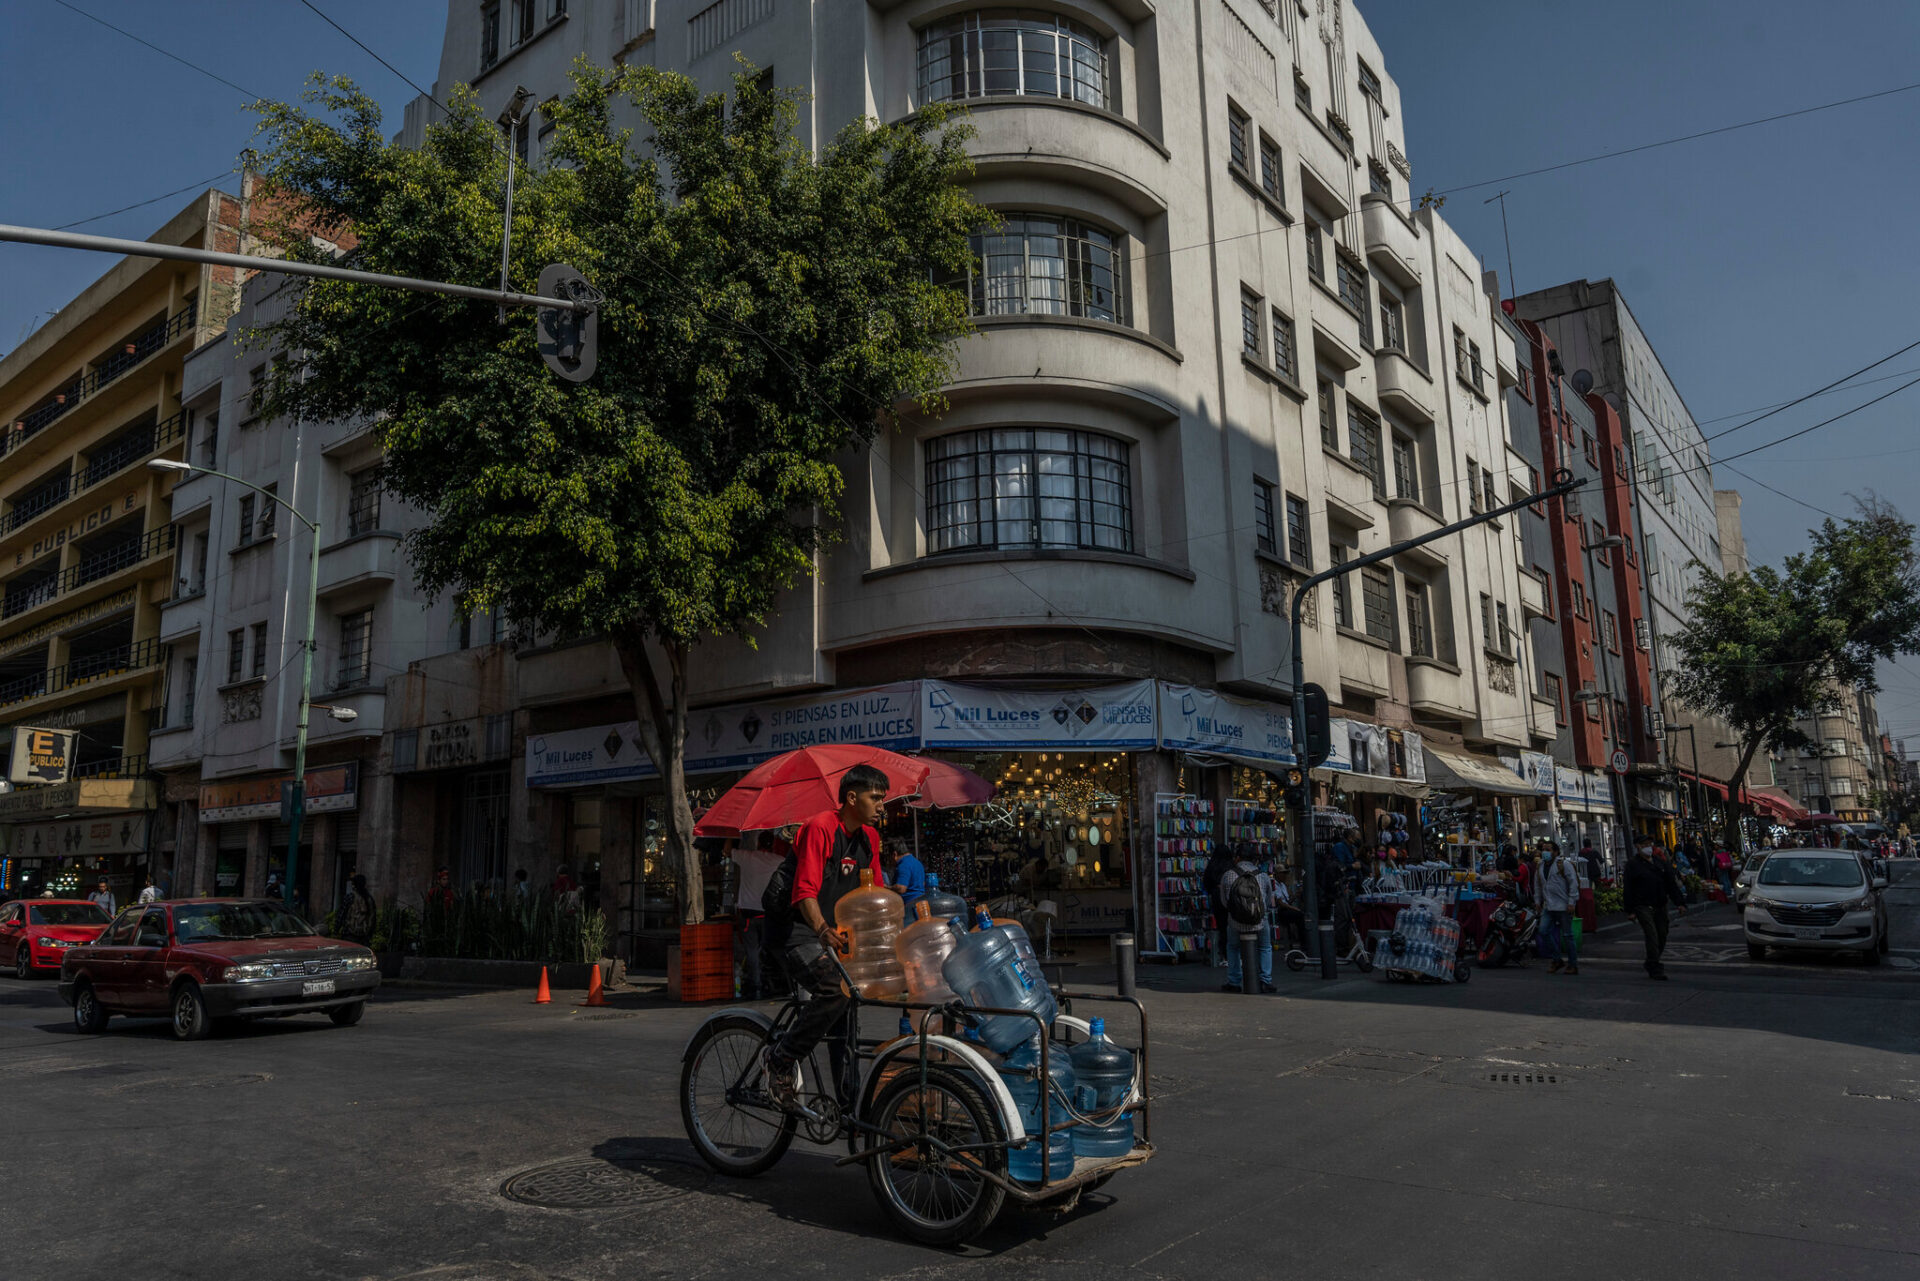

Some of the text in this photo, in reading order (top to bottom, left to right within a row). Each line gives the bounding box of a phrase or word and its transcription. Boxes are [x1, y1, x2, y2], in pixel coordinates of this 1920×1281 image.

[33, 504, 112, 558] PUBLICO
[125, 494, 135, 511] E
[771, 697, 900, 727] SI PIENSAS EN LUZ...
[954, 707, 1040, 721] Mil Luces
[1102, 705, 1151, 716] PIENSA EN
[1102, 714, 1152, 725] MIL LUCES
[1197, 716, 1243, 737] Mil Luces
[771, 718, 914, 749] PIENSA EN MIL LUCES
[32, 730, 54, 756] E
[30, 754, 65, 768] PUBLICO
[545, 749, 593, 766] Mil Luces
[1614, 754, 1627, 766] 40
[1081, 906, 1100, 917] Mil
